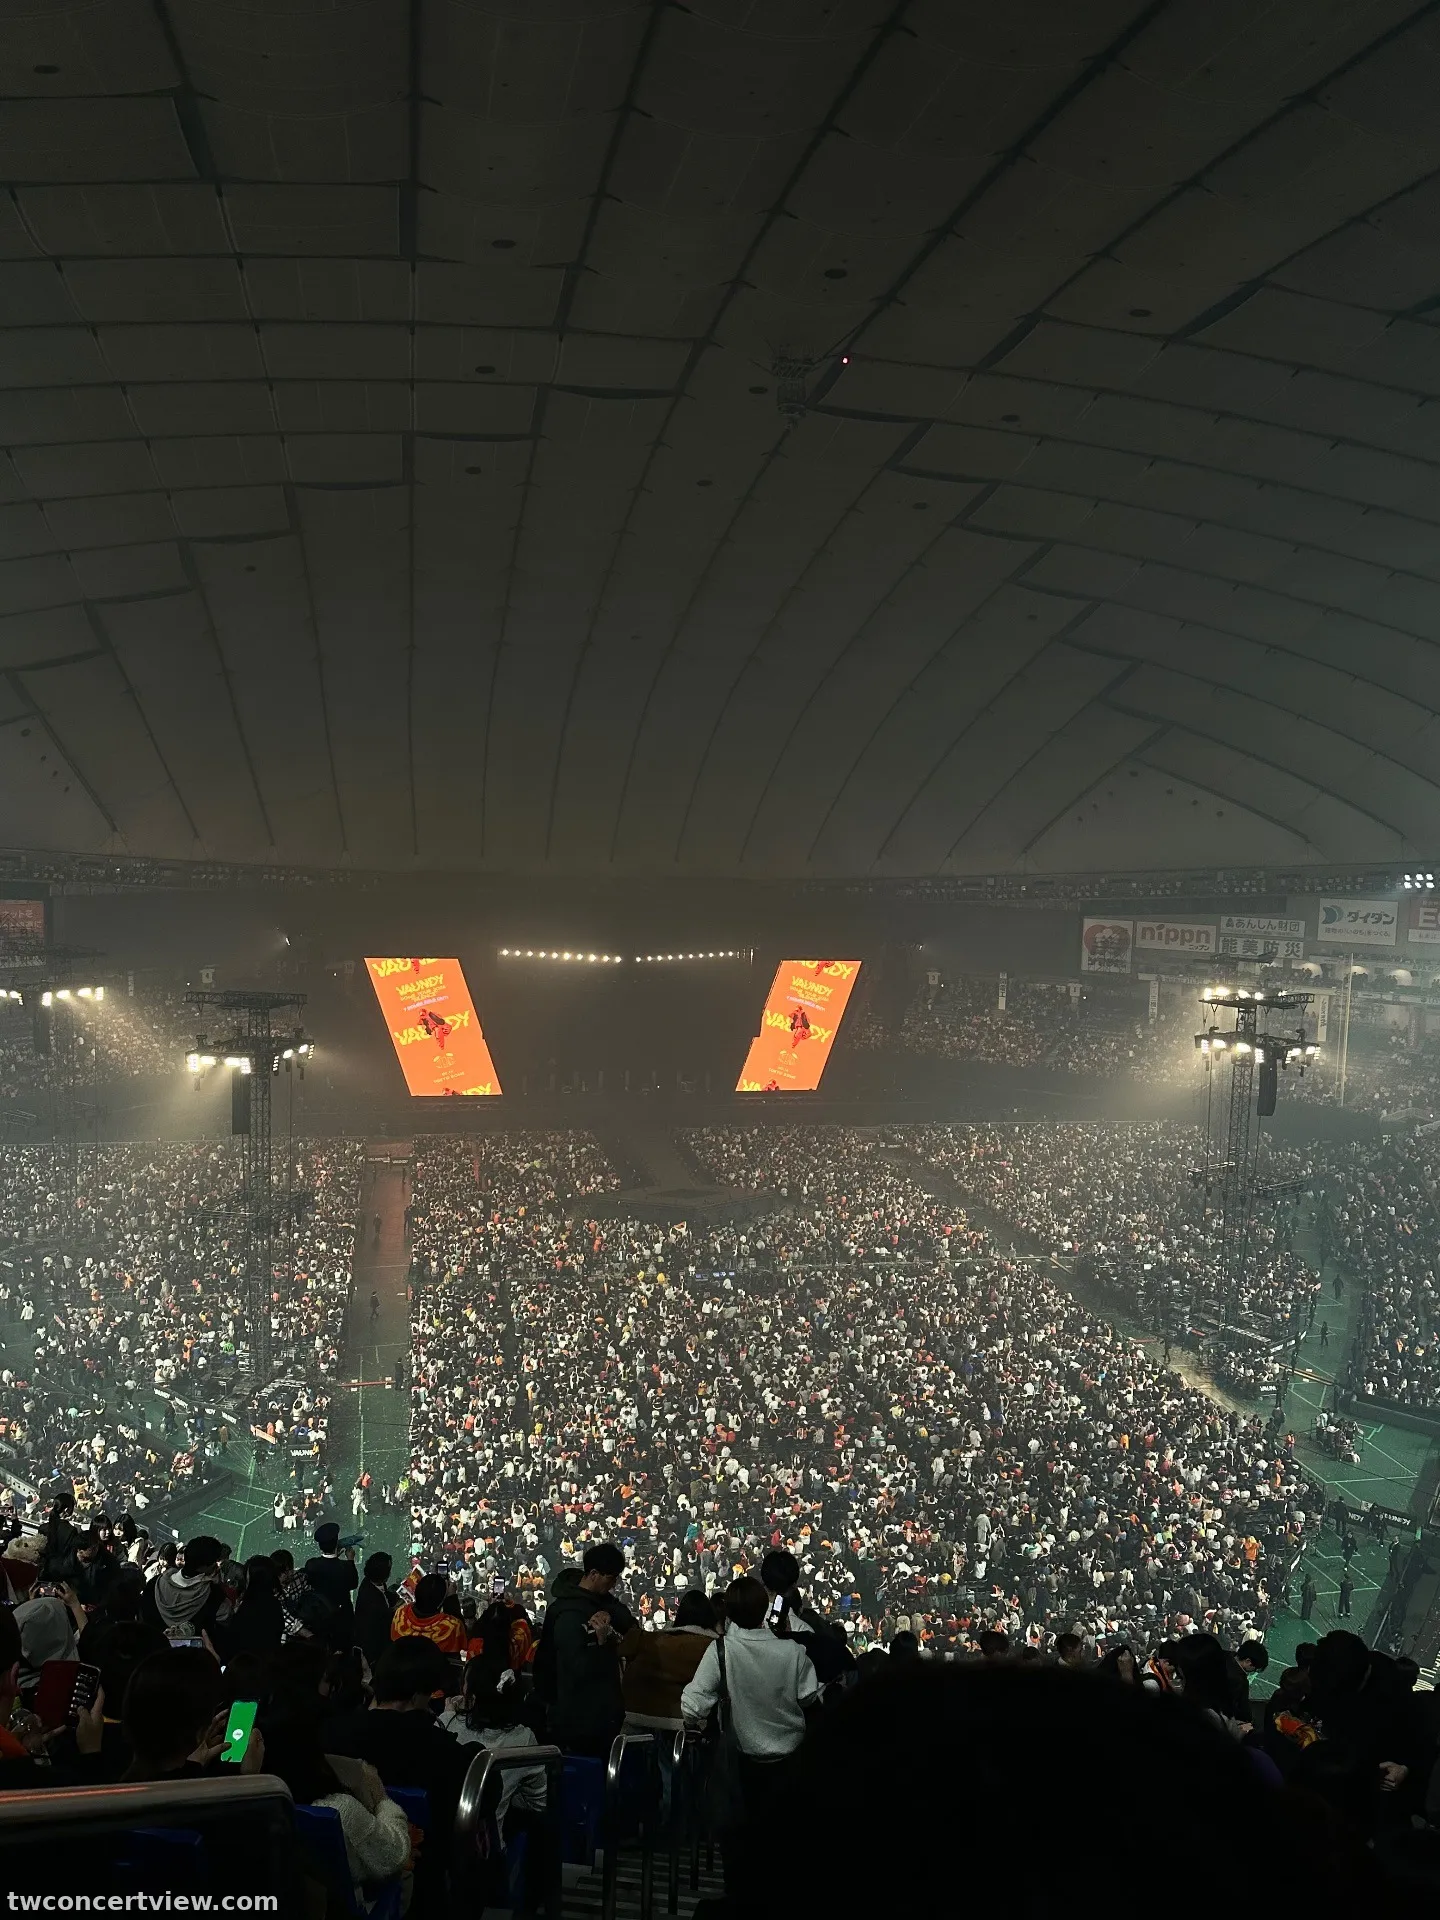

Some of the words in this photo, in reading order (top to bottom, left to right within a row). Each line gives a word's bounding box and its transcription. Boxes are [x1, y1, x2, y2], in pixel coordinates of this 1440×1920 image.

[1235, 919, 1300, 932] あんしん財団
[1347, 910, 1395, 925] ダイダン
[1141, 924, 1211, 945] nippn
[1221, 938, 1301, 958] 能美防災
[396, 974, 444, 995] VAUNDY
[792, 976, 834, 995] VAUNDY
